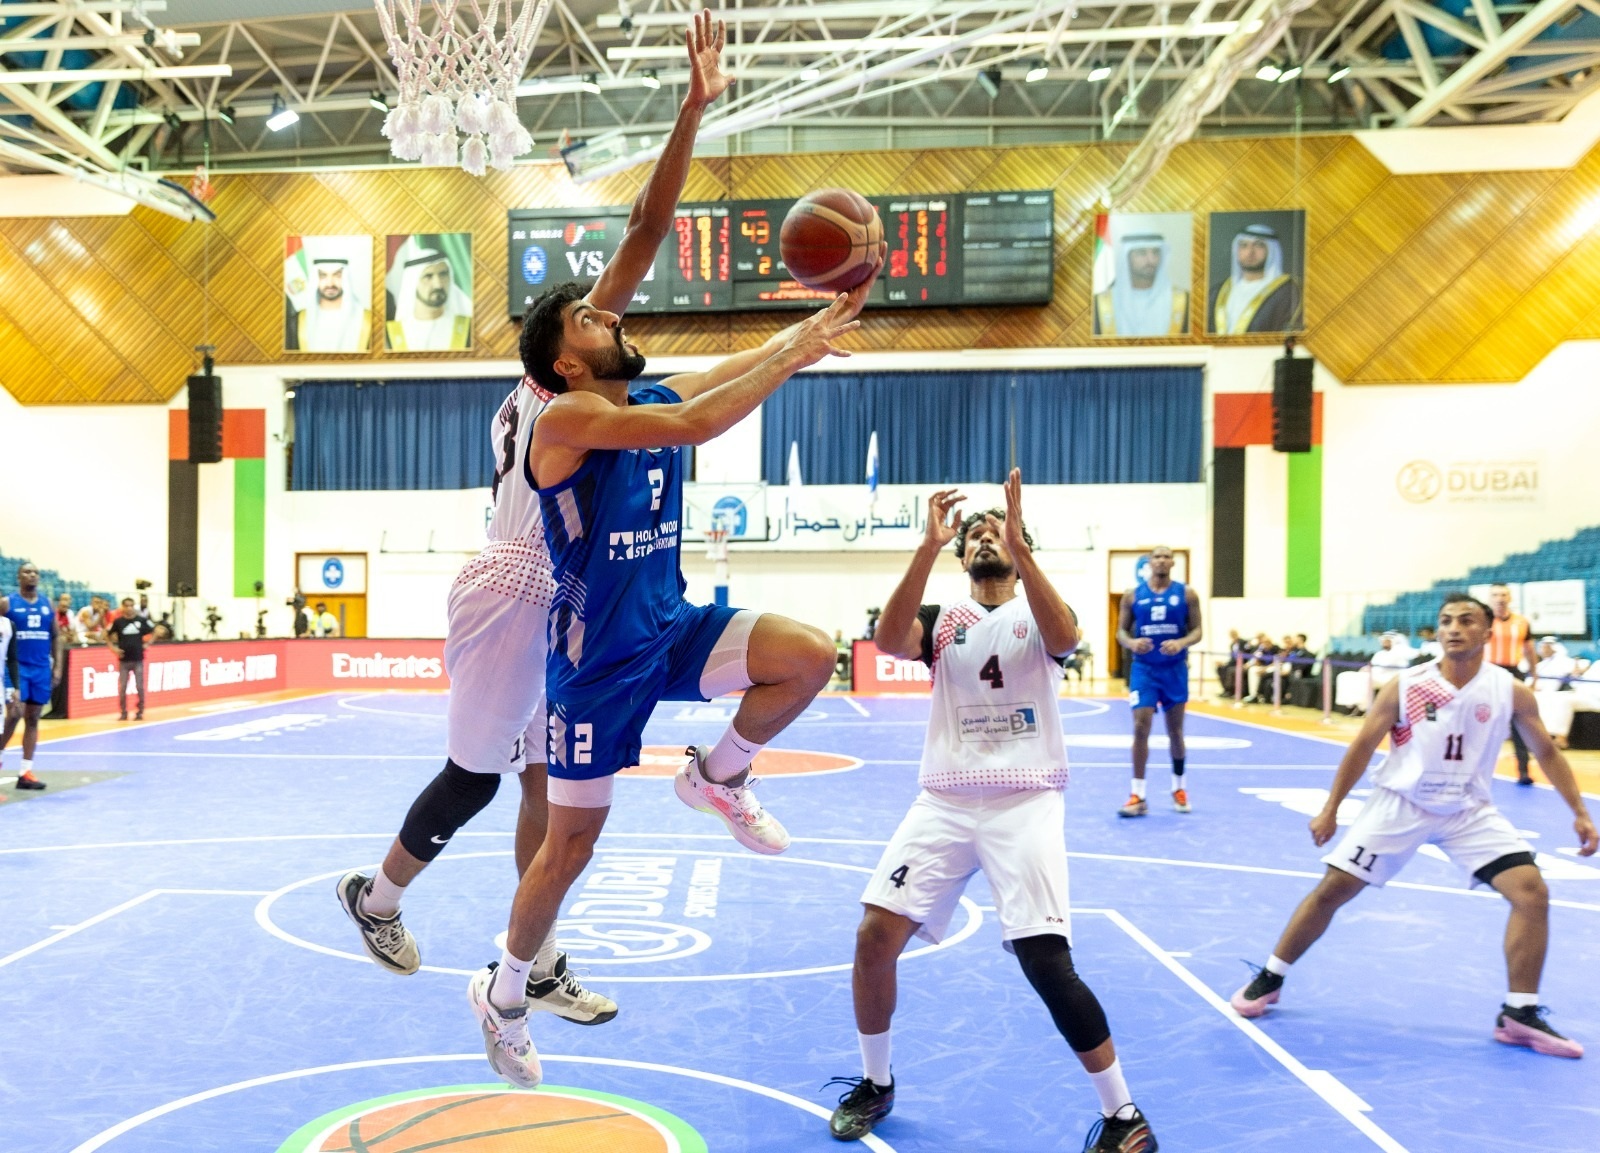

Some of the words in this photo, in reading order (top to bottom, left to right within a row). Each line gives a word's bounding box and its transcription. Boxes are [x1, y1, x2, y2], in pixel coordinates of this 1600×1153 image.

[741, 221, 770, 244] 43
[565, 250, 604, 276] VS
[758, 256, 772, 275] 2
[648, 468, 664, 511] 2
[1448, 470, 1538, 492] DUBAI
[332, 652, 442, 678] Emirates
[979, 655, 1004, 689] 4
[574, 722, 593, 764] 2
[1443, 734, 1463, 761] 11
[1349, 846, 1378, 872] 11
[567, 856, 678, 917] DUBAI
[890, 864, 910, 888] 4
